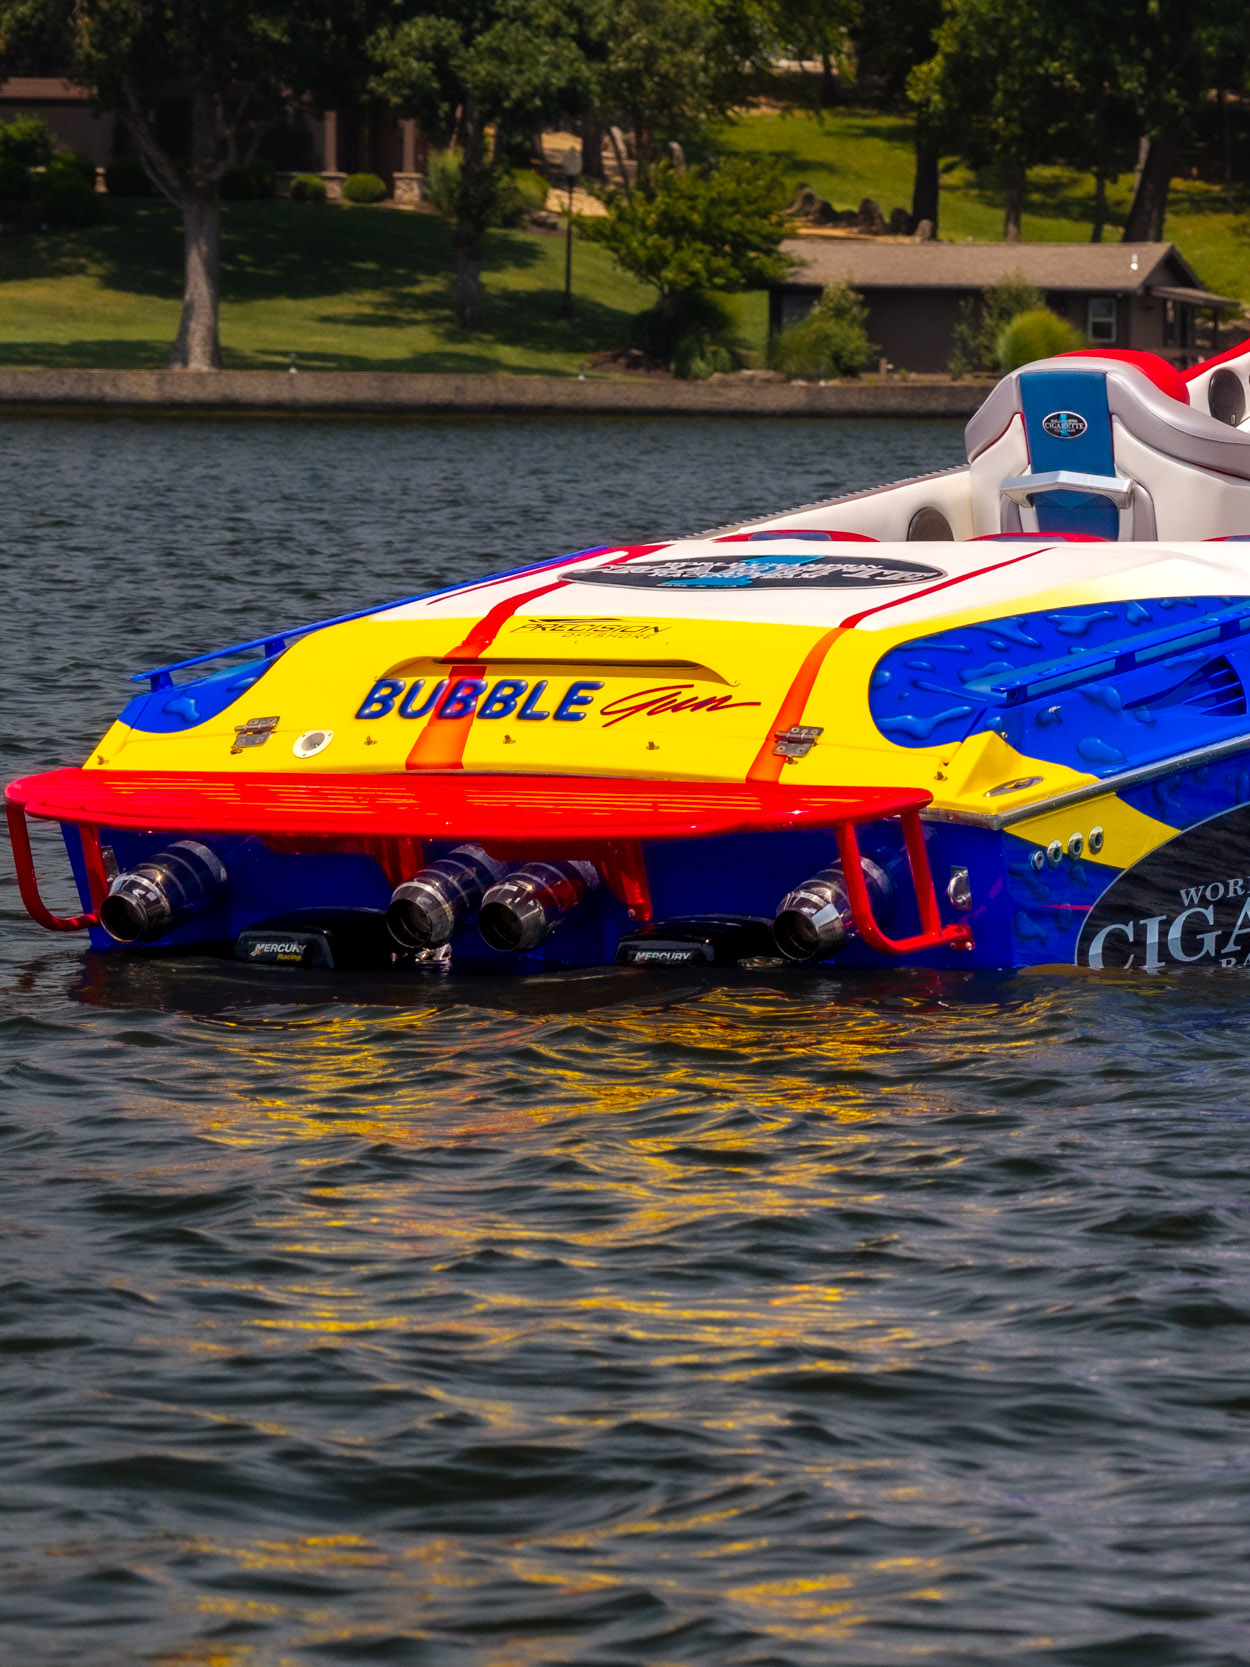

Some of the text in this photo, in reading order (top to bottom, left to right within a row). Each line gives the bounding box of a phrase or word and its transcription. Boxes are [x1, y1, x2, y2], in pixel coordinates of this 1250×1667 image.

[510, 623, 673, 633] PRECISION
[355, 678, 605, 723] BUBBLE
[254, 943, 307, 954] MERCURY
[635, 952, 690, 961] MERCURY
